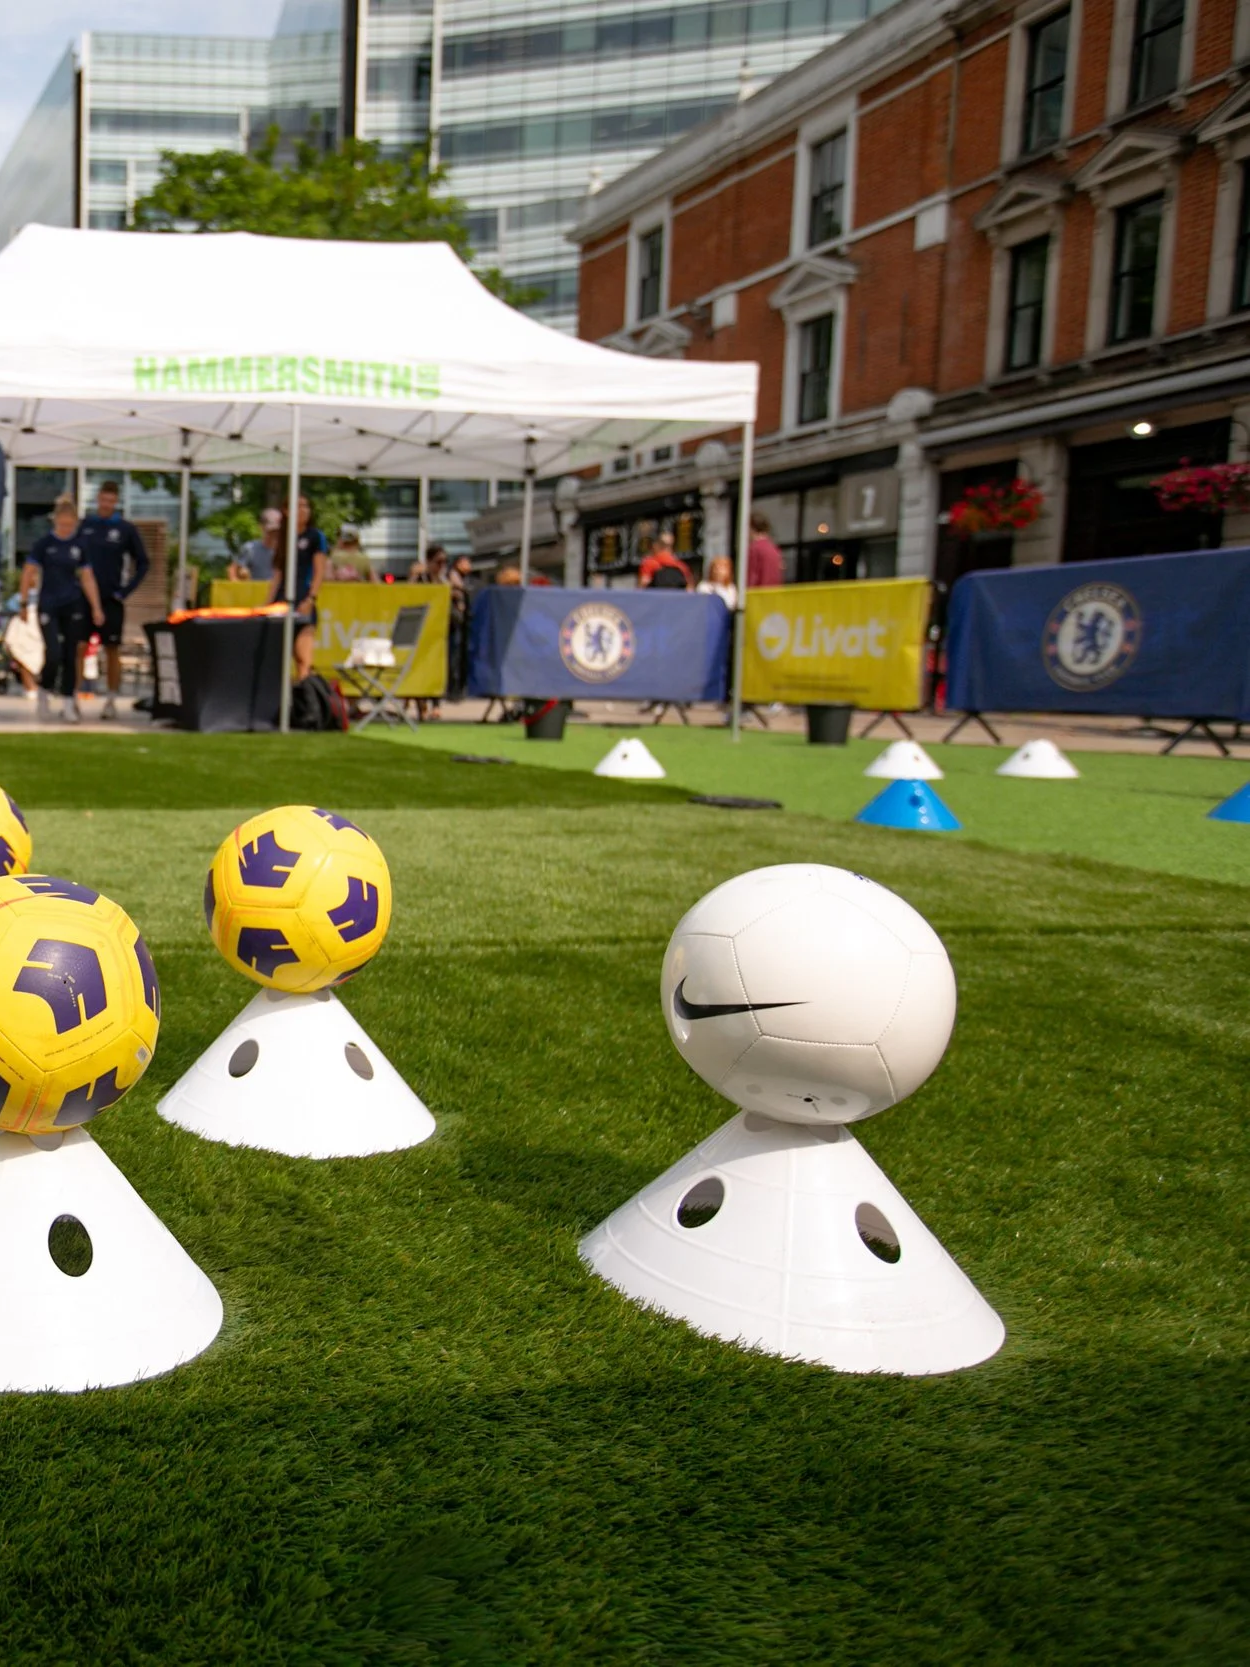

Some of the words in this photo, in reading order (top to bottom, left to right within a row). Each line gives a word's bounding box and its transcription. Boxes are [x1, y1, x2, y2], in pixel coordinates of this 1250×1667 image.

[133, 356, 411, 399] HAMMERSMITH
[313, 608, 393, 649] iva
[792, 614, 887, 660] Livat
